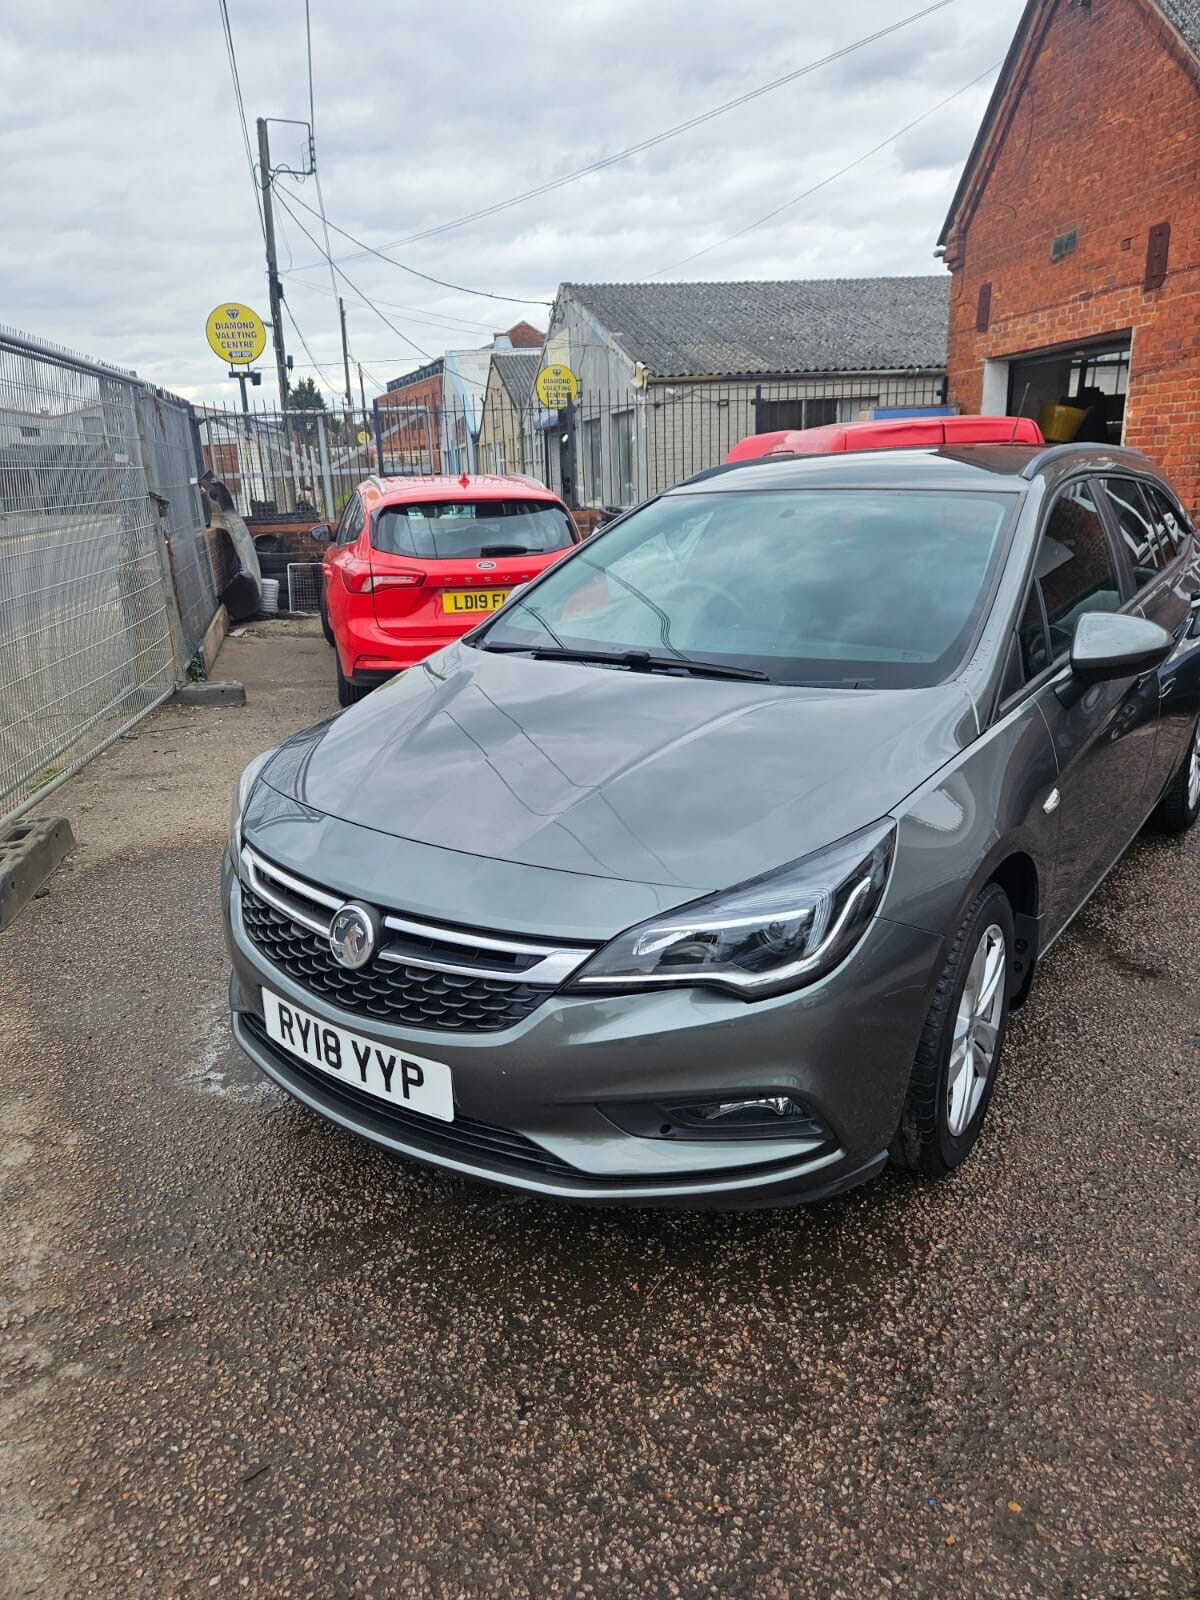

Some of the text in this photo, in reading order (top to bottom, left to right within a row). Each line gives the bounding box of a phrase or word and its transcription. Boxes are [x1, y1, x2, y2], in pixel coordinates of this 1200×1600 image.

[215, 321, 255, 330] DIAMOND
[215, 331, 257, 339] VALETING
[221, 340, 255, 349] CENTRE
[453, 594, 488, 610] LD19
[278, 1002, 425, 1100] RY18 YYP
